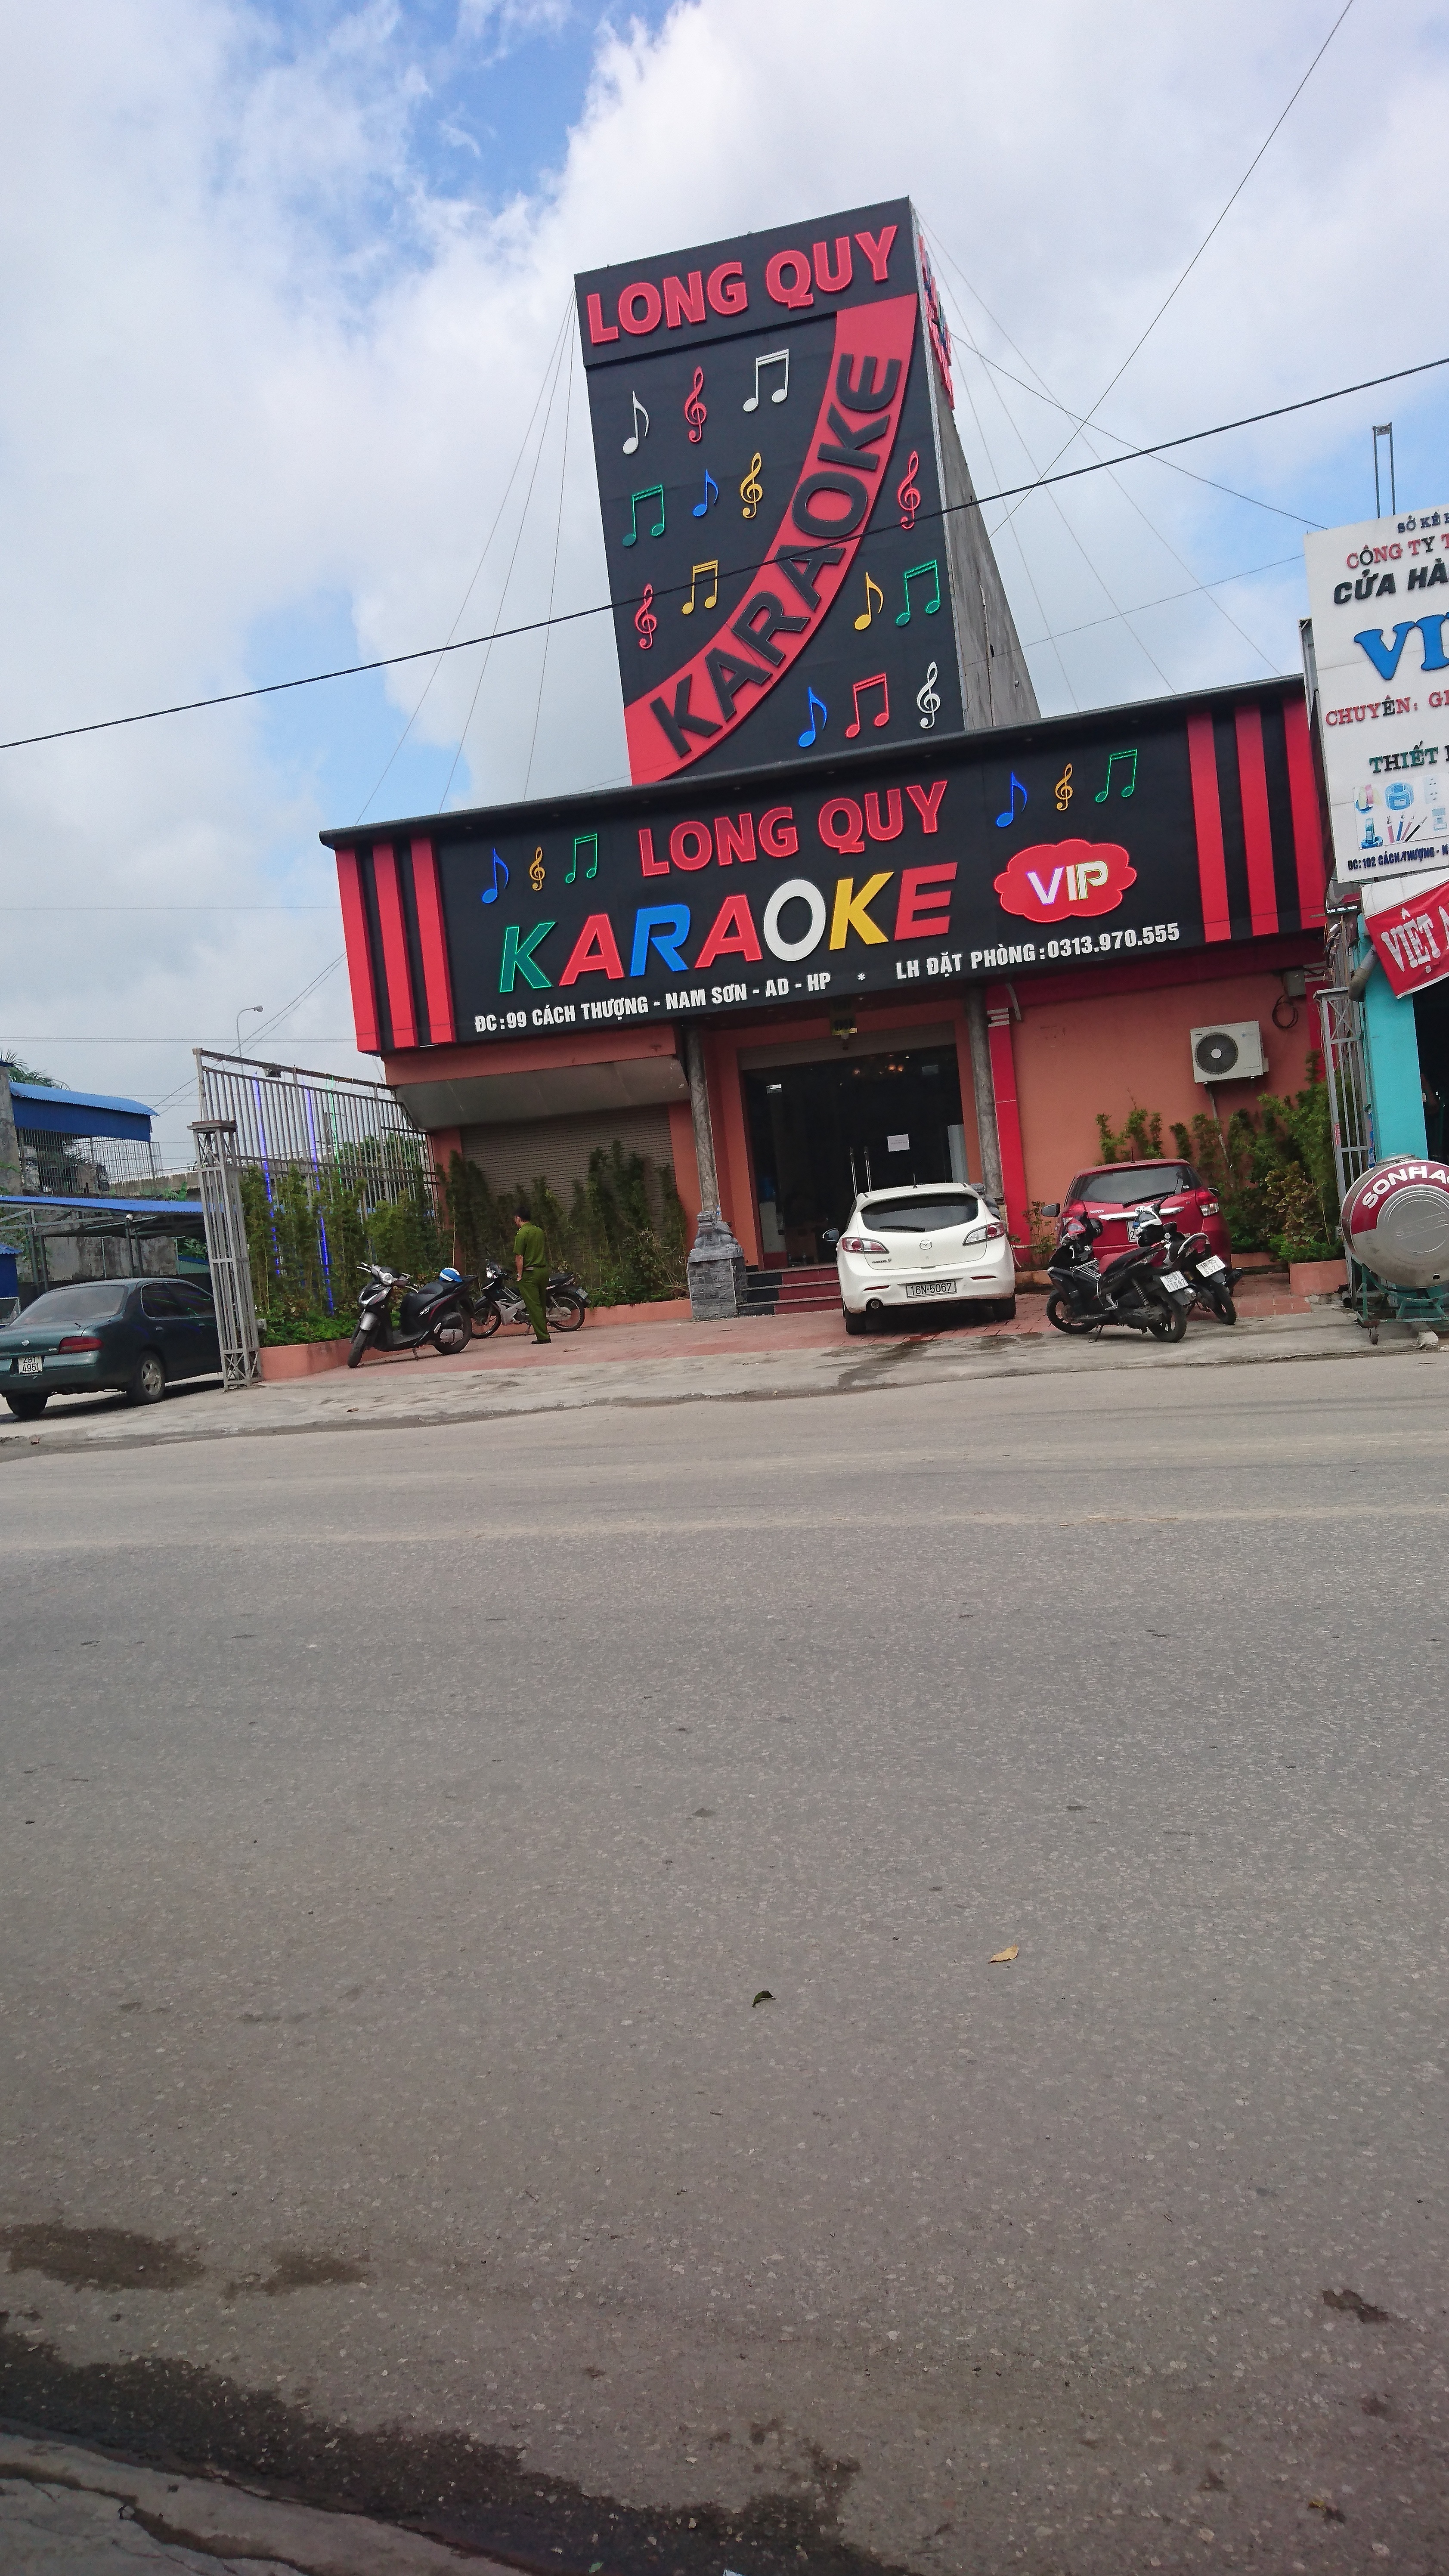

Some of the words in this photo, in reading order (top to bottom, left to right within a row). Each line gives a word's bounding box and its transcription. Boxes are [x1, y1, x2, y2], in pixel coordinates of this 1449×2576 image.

[586, 261, 748, 345] LONG
[765, 226, 898, 310] QUY
[650, 353, 901, 759] KARAOKE
[1346, 544, 1403, 569] CÔNG
[1408, 536, 1435, 555] TY
[1334, 569, 1396, 604] CỬA
[1408, 558, 1449, 591] HÀ
[1353, 611, 1449, 680] VI
[1369, 740, 1438, 773] THIẾT
[639, 807, 799, 878] LONG
[818, 781, 947, 854] QUY
[1027, 861, 1108, 905] VIP
[499, 862, 957, 993] KARAOKE
[1381, 907, 1441, 973] VIỆT
[896, 960, 919, 979] LH
[927, 952, 962, 977] ĐẶT
[532, 1004, 576, 1026] CÁCH
[581, 996, 648, 1020] THƯỢNG
[666, 989, 706, 1010] NAM
[712, 983, 747, 1003] SƠN
[765, 978, 789, 997] AD
[807, 972, 831, 991] HP
[1362, 1165, 1449, 1209] SONHA
[910, 1282, 952, 1295] 16N-5067
[22, 1363, 39, 1372] 4951
